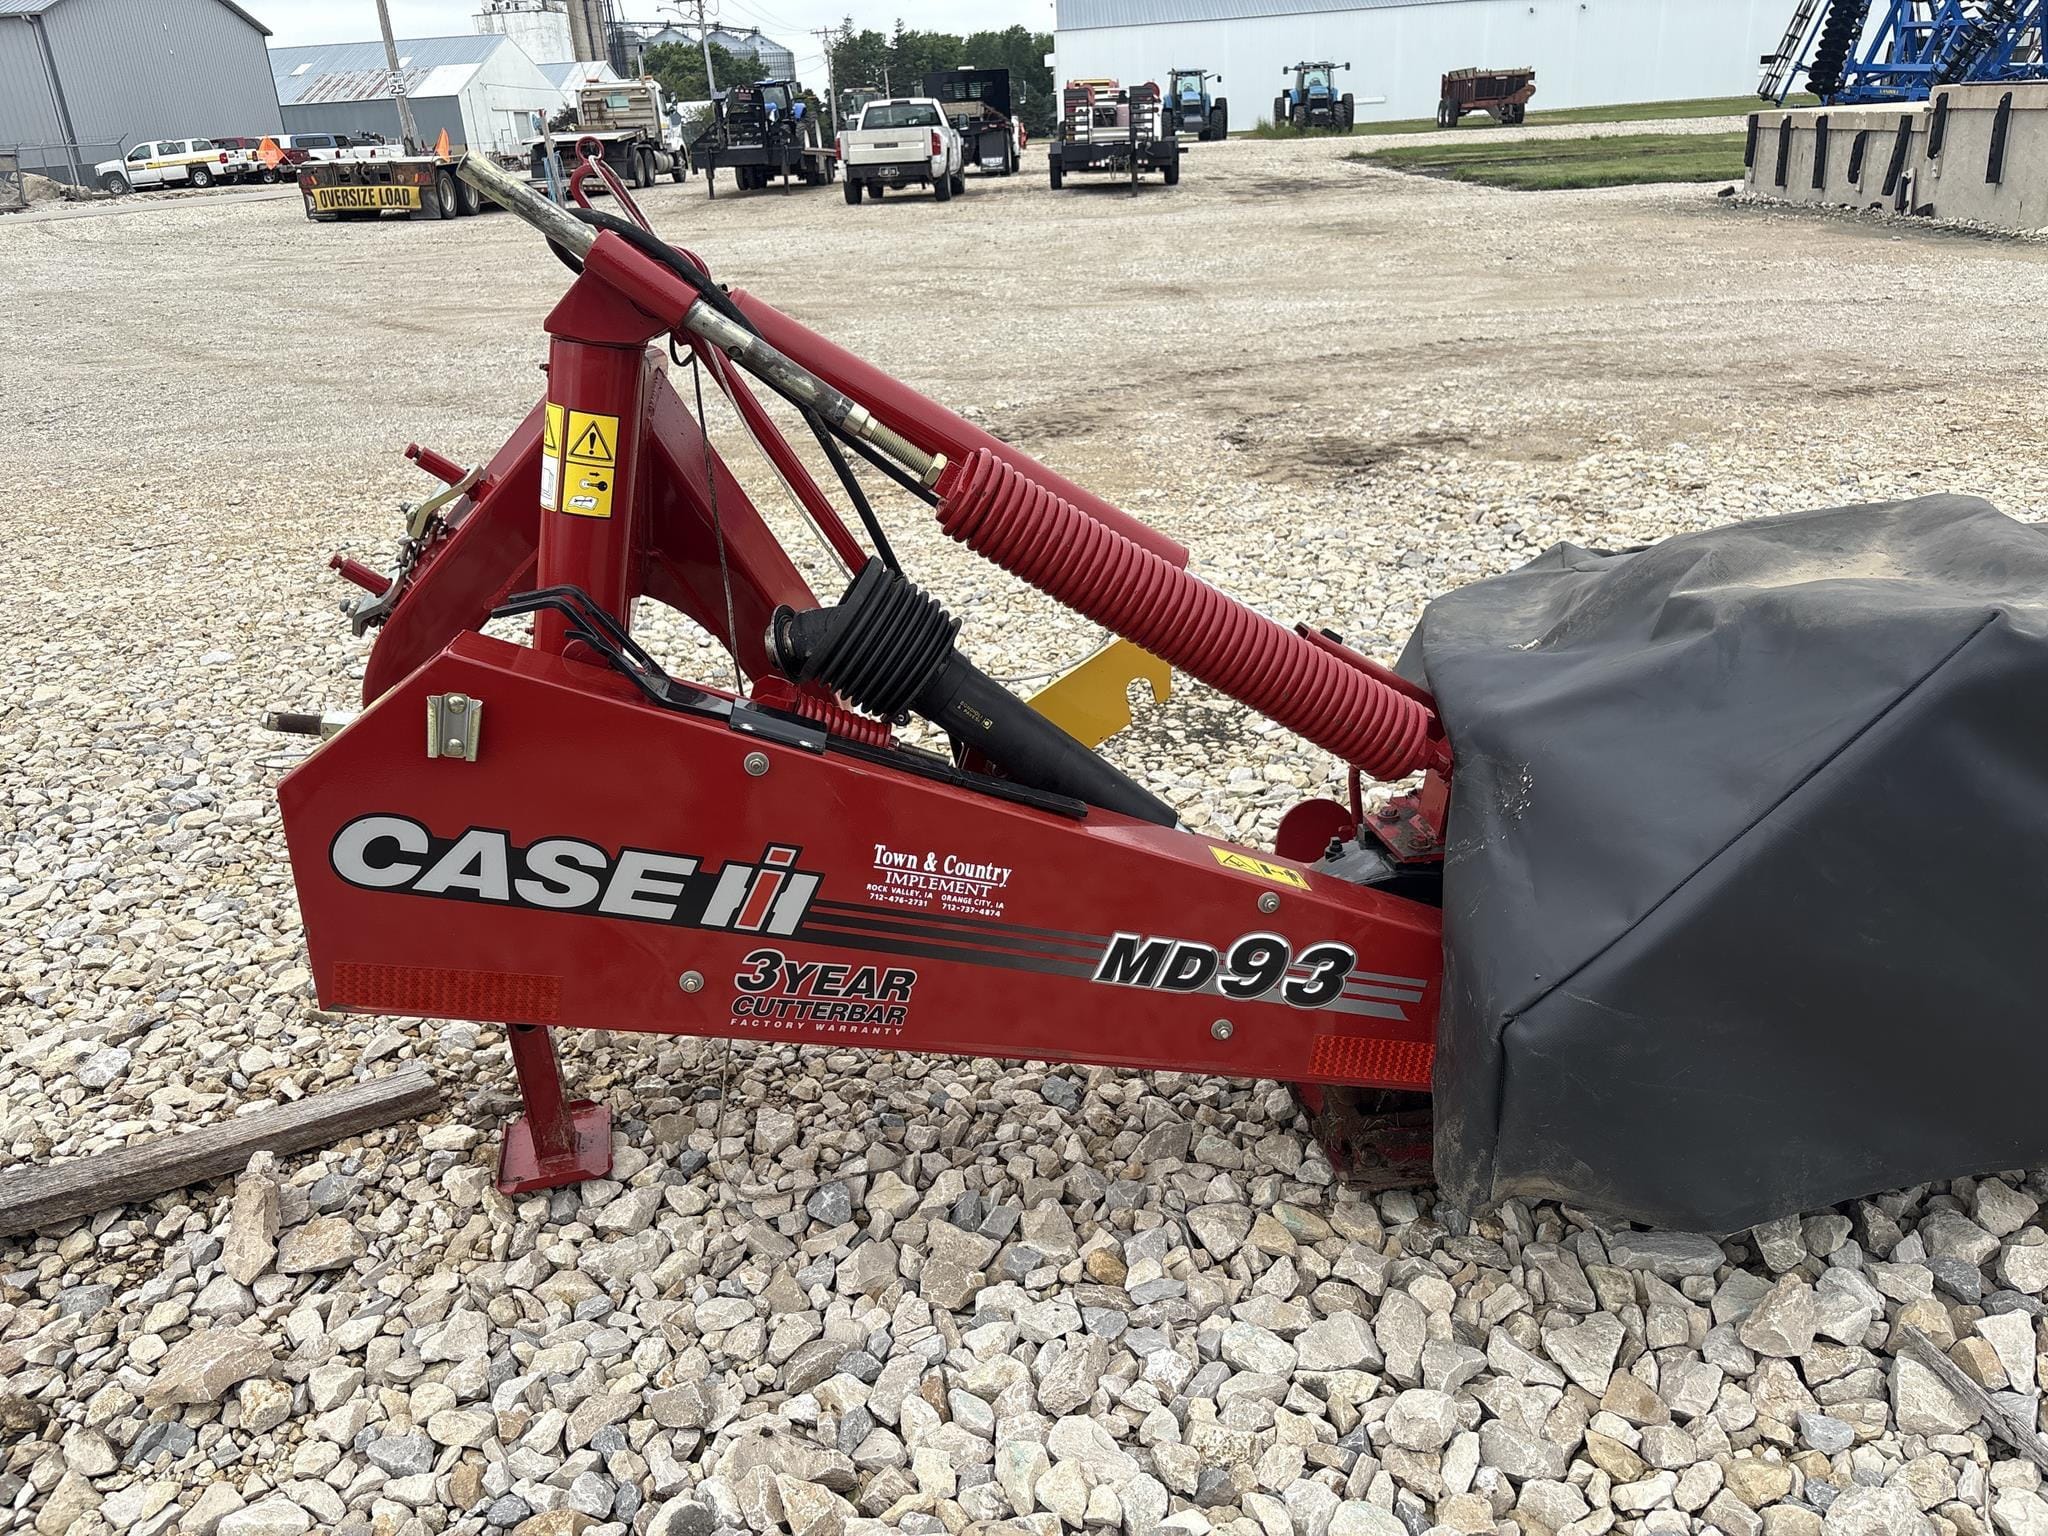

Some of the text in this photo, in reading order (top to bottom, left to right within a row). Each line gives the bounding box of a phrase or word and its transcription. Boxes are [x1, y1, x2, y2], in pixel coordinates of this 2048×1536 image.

[390, 84, 405, 94] 25
[319, 188, 411, 209] OVERSIZE LOAD
[331, 816, 698, 920] CASE
[874, 844, 1012, 887] Town & Country
[866, 884, 888, 892] ROCK
[891, 887, 922, 898] VALLEY,
[885, 872, 992, 897] IMPLEMENT
[869, 893, 928, 907] 712-476-2731
[941, 894, 972, 905] ORANGE
[974, 899, 993, 908] CITY,
[942, 903, 1001, 917] 712-737-4874
[1090, 931, 1358, 1008] MD93
[732, 995, 908, 1025] CUTTERBAR
[730, 1018, 903, 1036] FACTORY WARRANTY
